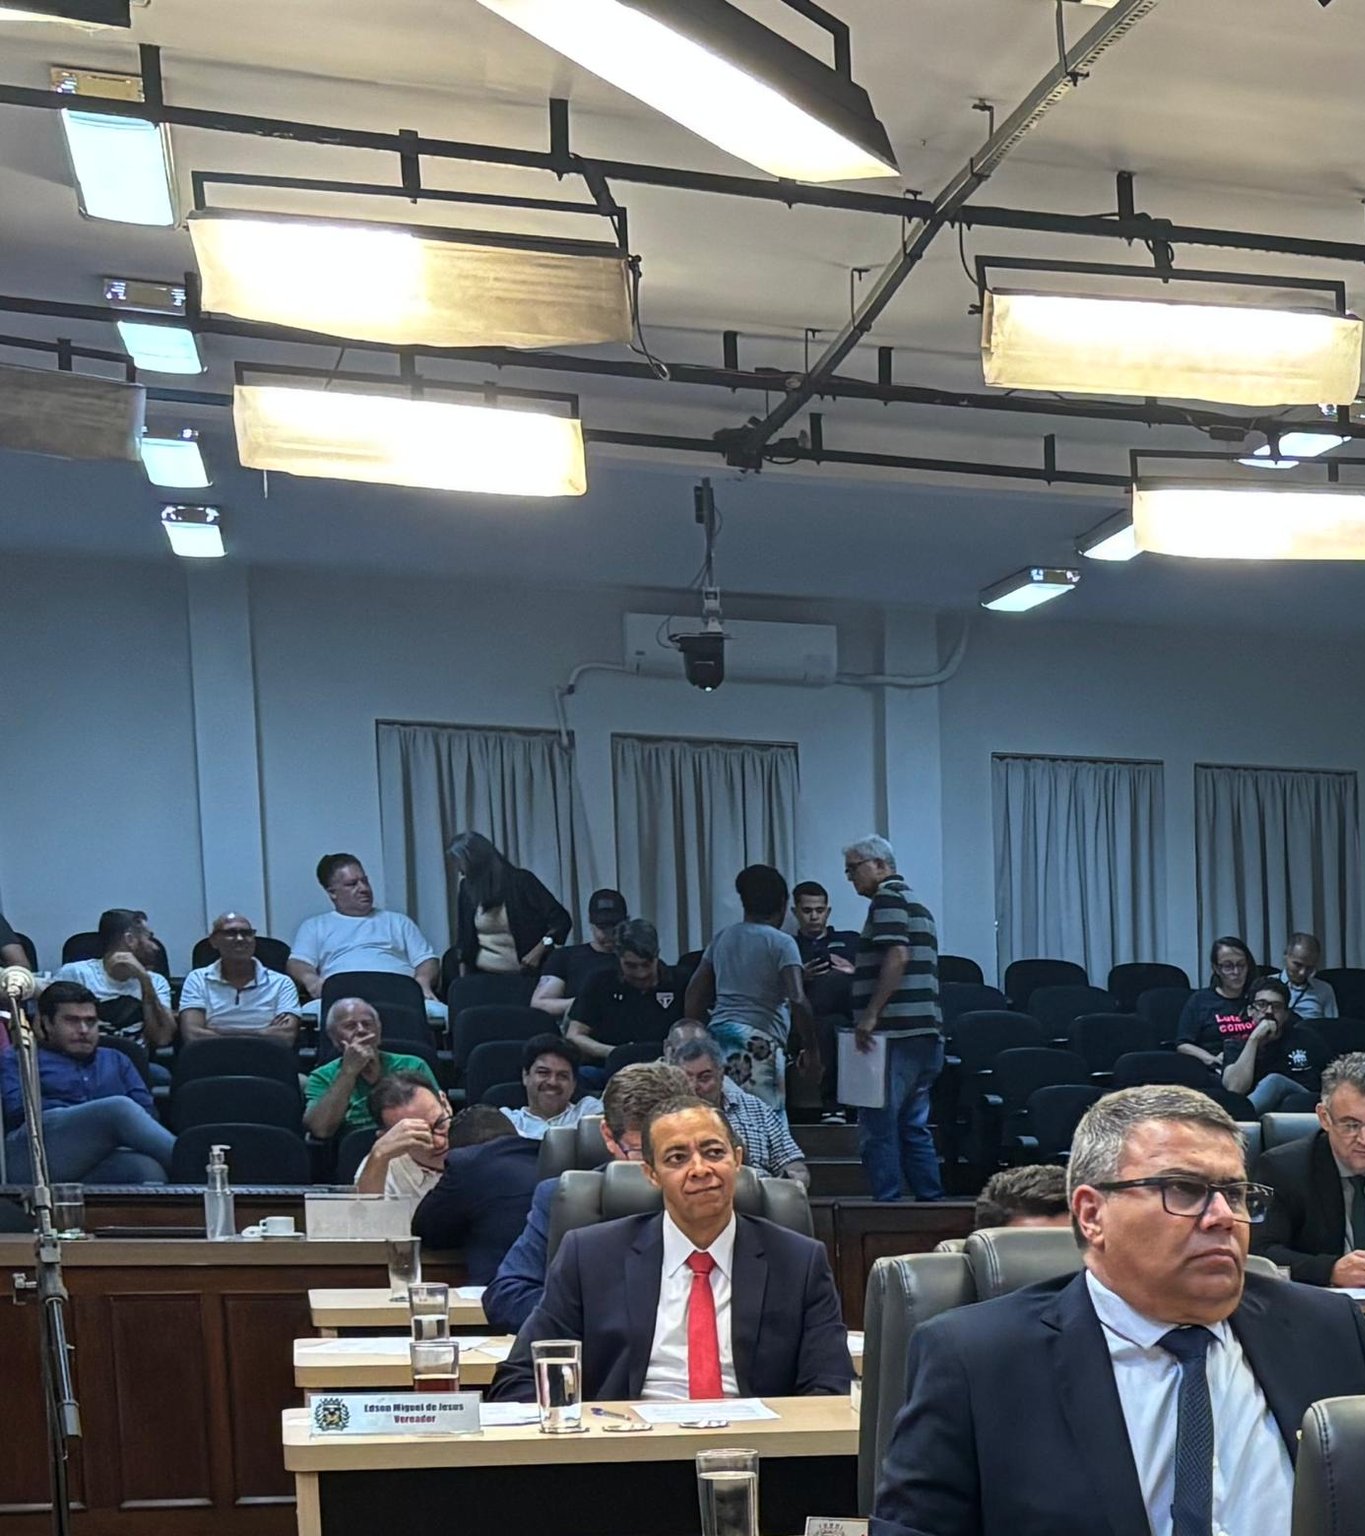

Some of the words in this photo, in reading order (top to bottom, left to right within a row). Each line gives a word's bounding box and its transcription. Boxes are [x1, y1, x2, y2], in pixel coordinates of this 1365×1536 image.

[363, 1403, 391, 1412] Edson
[393, 1403, 424, 1412] Miguel
[425, 1403, 437, 1411] de
[439, 1403, 464, 1411] Jesus
[394, 1415, 436, 1423] Vereador
